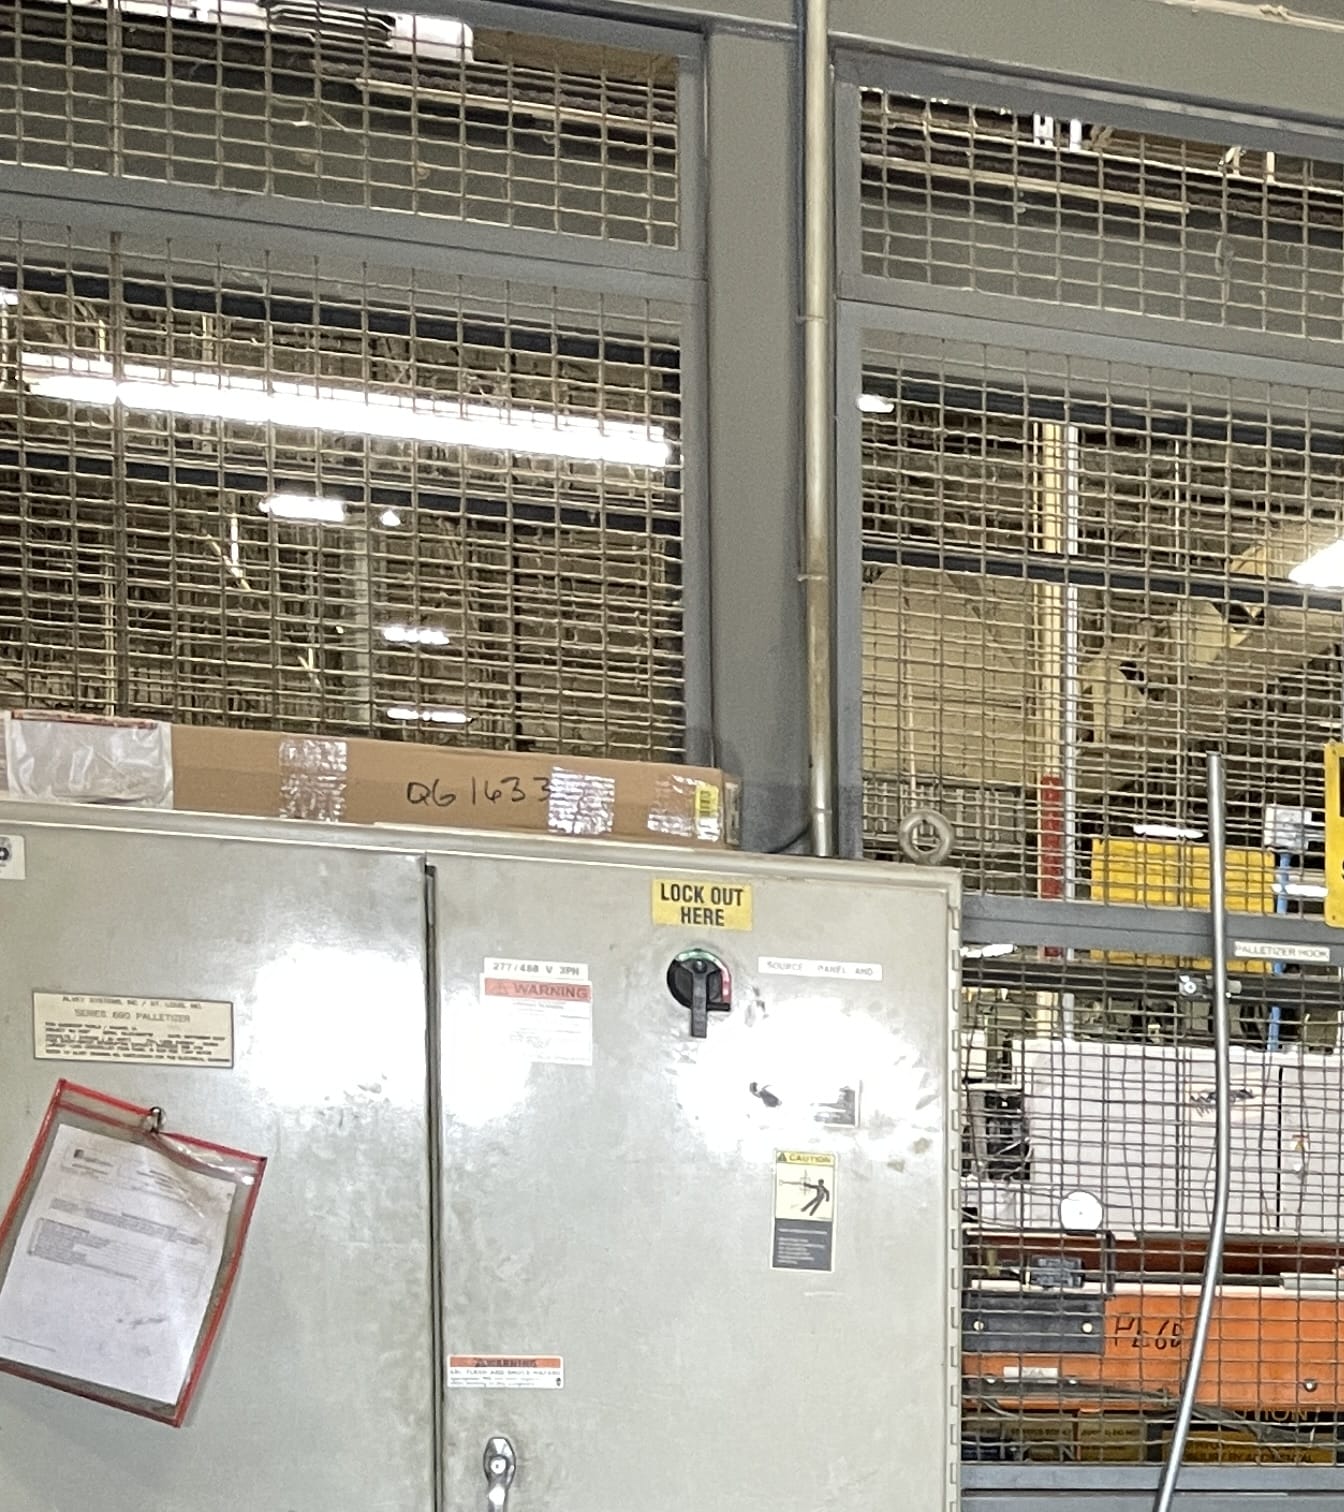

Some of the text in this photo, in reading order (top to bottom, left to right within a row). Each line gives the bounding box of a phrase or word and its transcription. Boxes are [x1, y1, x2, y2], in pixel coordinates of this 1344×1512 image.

[660, 883, 744, 907] LOCK OUT
[680, 906, 725, 927] HERE
[545, 965, 553, 974] V
[512, 982, 589, 999] WARNING
[789, 1153, 831, 1164] CAUTION
